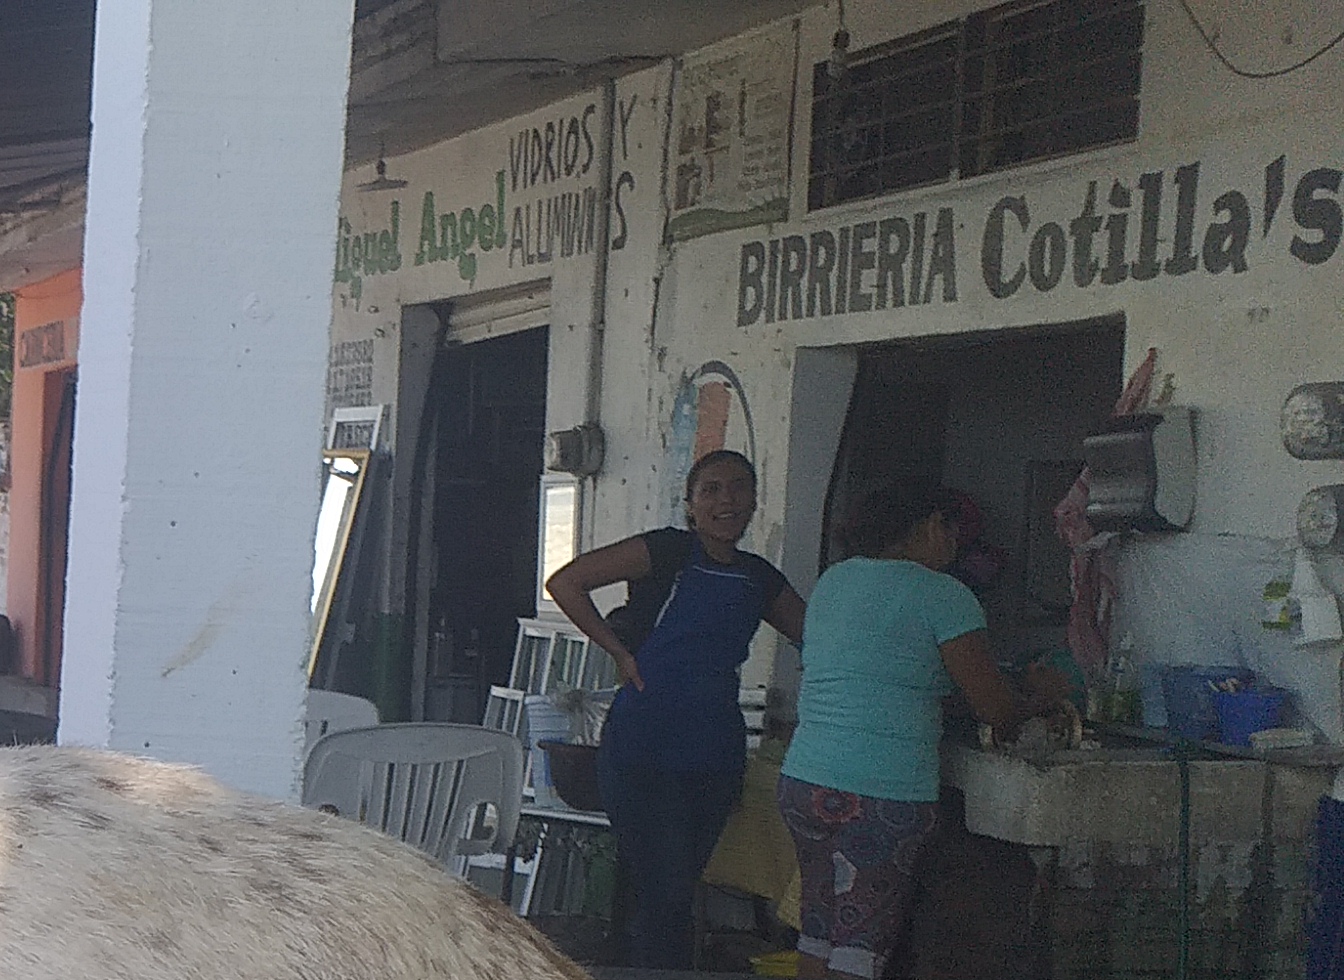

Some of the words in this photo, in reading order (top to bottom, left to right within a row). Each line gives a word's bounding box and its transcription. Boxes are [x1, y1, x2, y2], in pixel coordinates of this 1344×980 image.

[510, 104, 596, 192] VIDRIOS
[335, 200, 402, 301] iguel
[414, 169, 507, 282] Angel
[737, 207, 959, 327] BIRRIERIA
[981, 154, 1344, 299] Cotilla's
